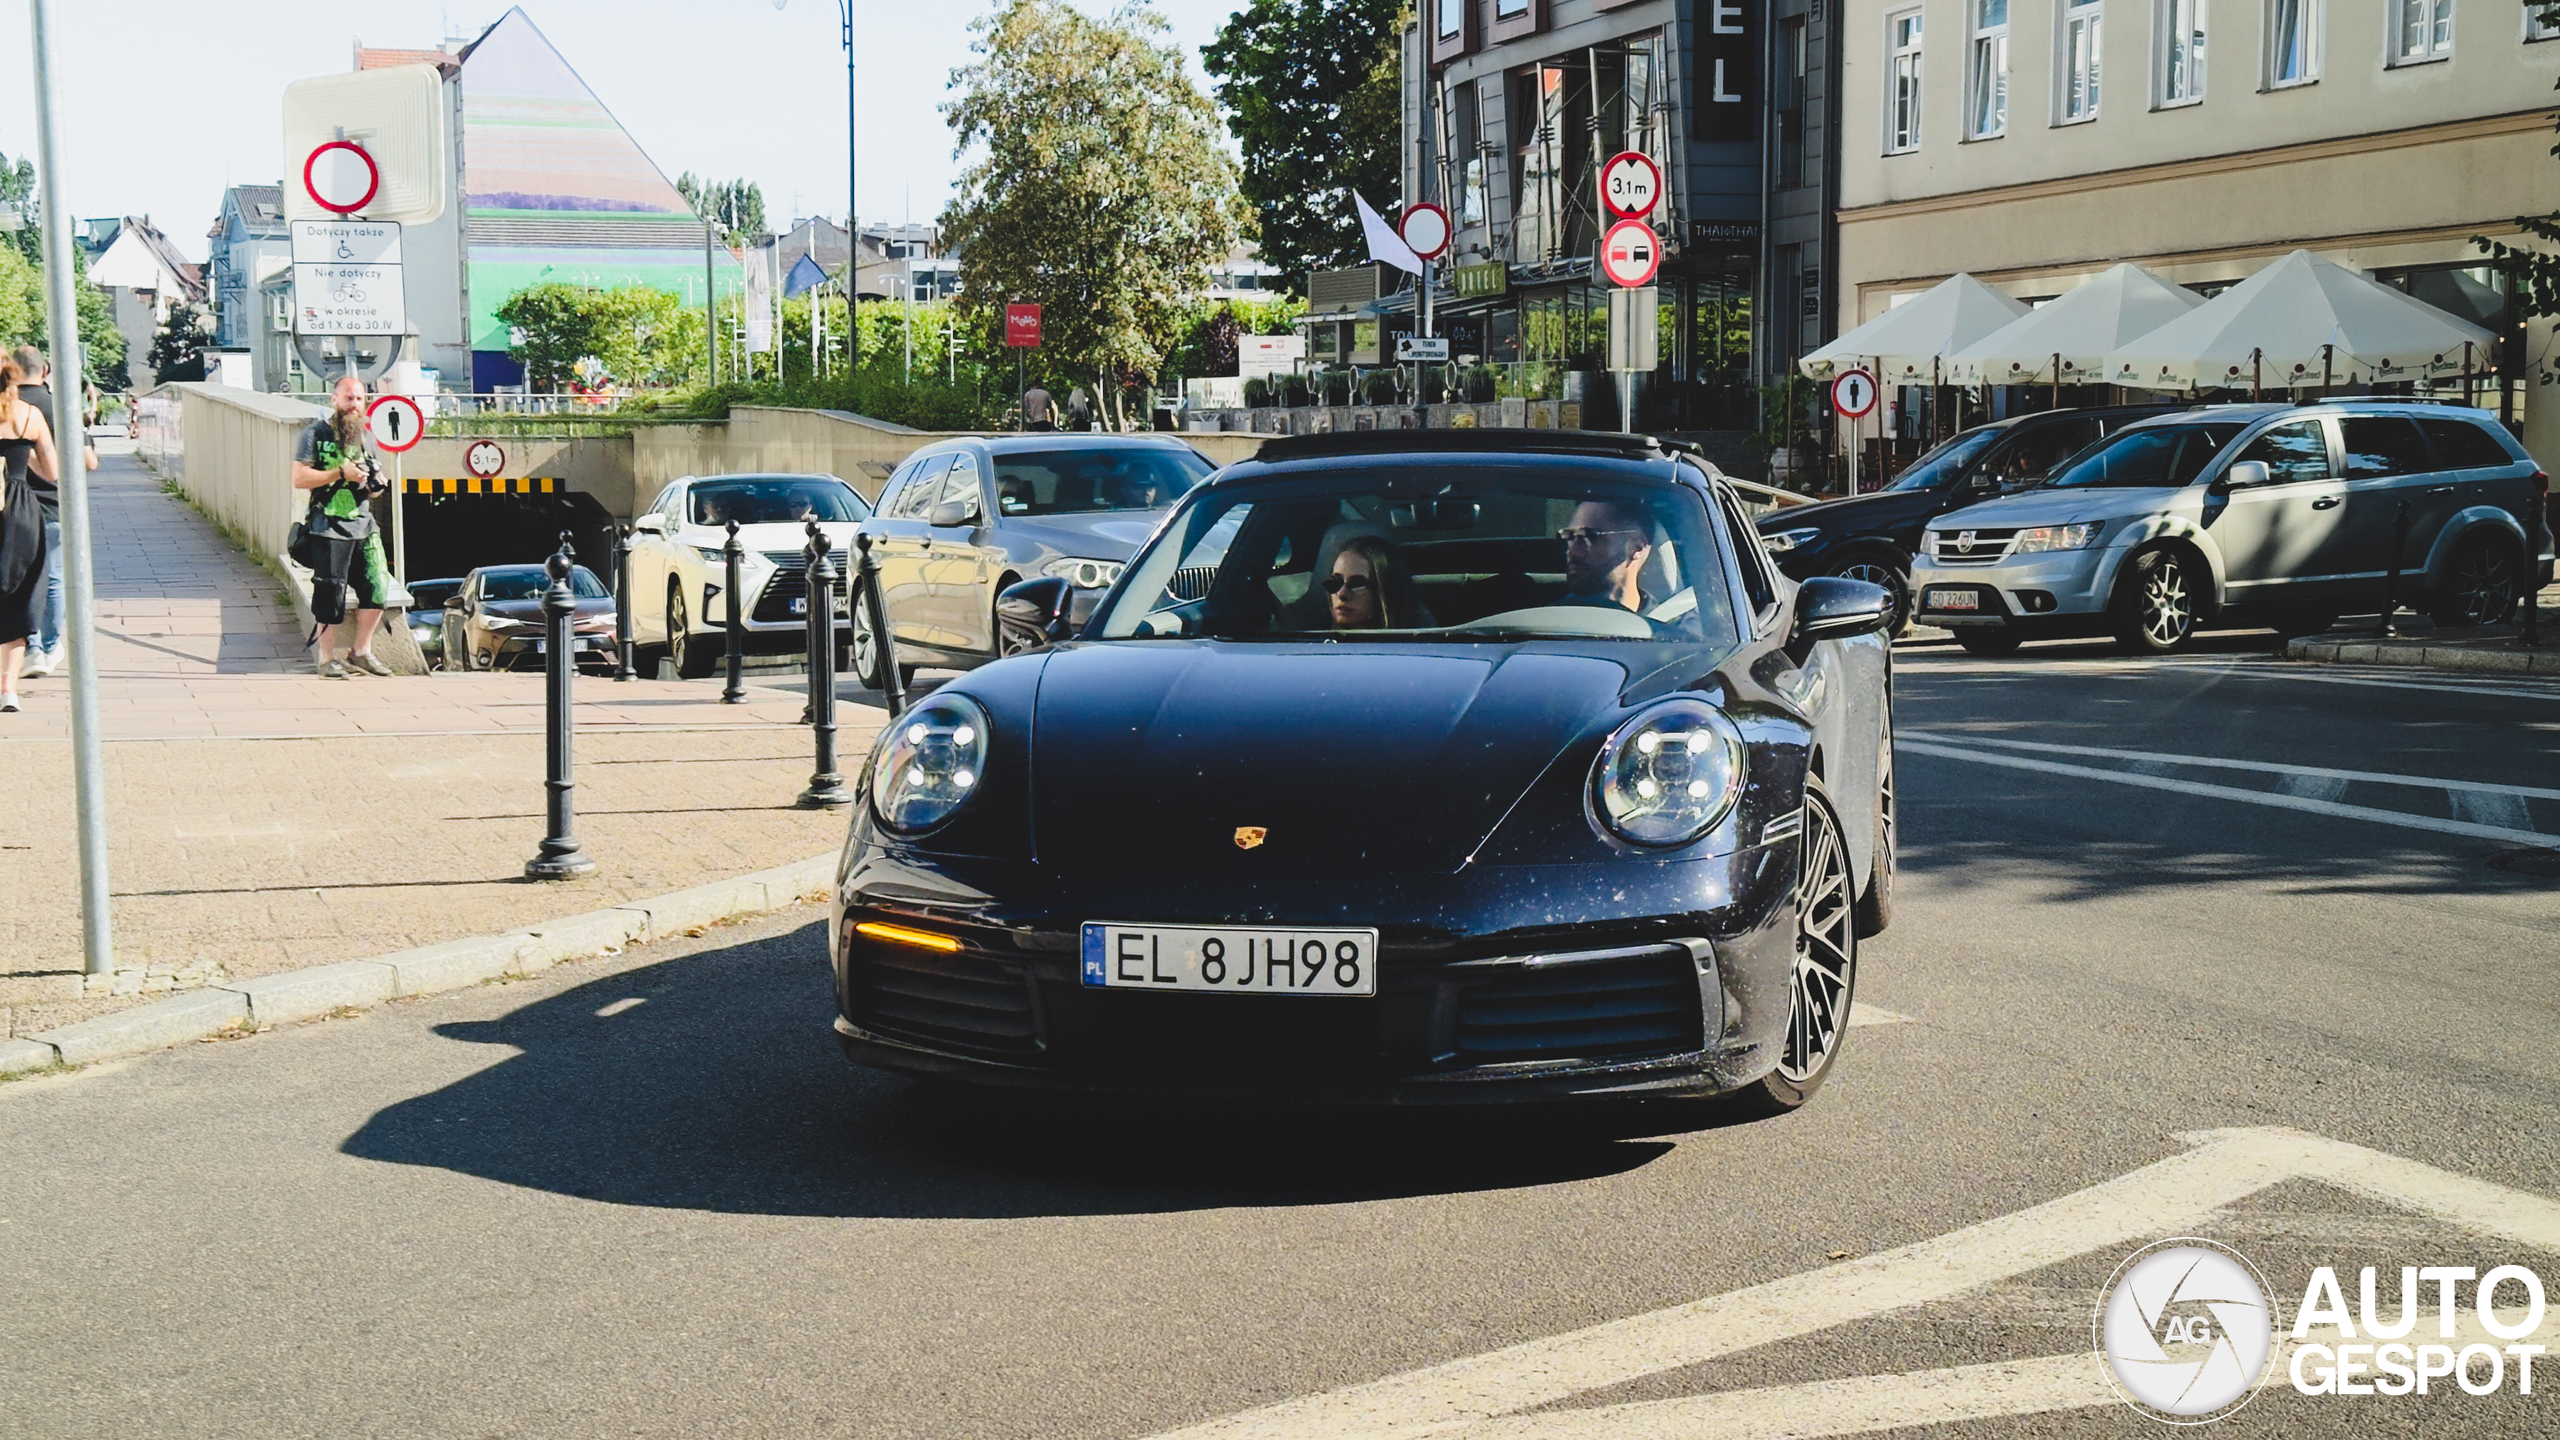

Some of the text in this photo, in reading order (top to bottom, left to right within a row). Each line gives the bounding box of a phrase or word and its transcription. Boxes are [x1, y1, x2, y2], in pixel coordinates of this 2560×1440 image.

[307, 226, 385, 238] Dotyczy także
[314, 268, 382, 280] Nie dotyczy
[325, 306, 378, 316] w okresie
[310, 320, 325, 330] od
[347, 320, 361, 330] do
[365, 320, 393, 330] 30.IV
[1086, 933, 1361, 988] PL EL 8JH98
